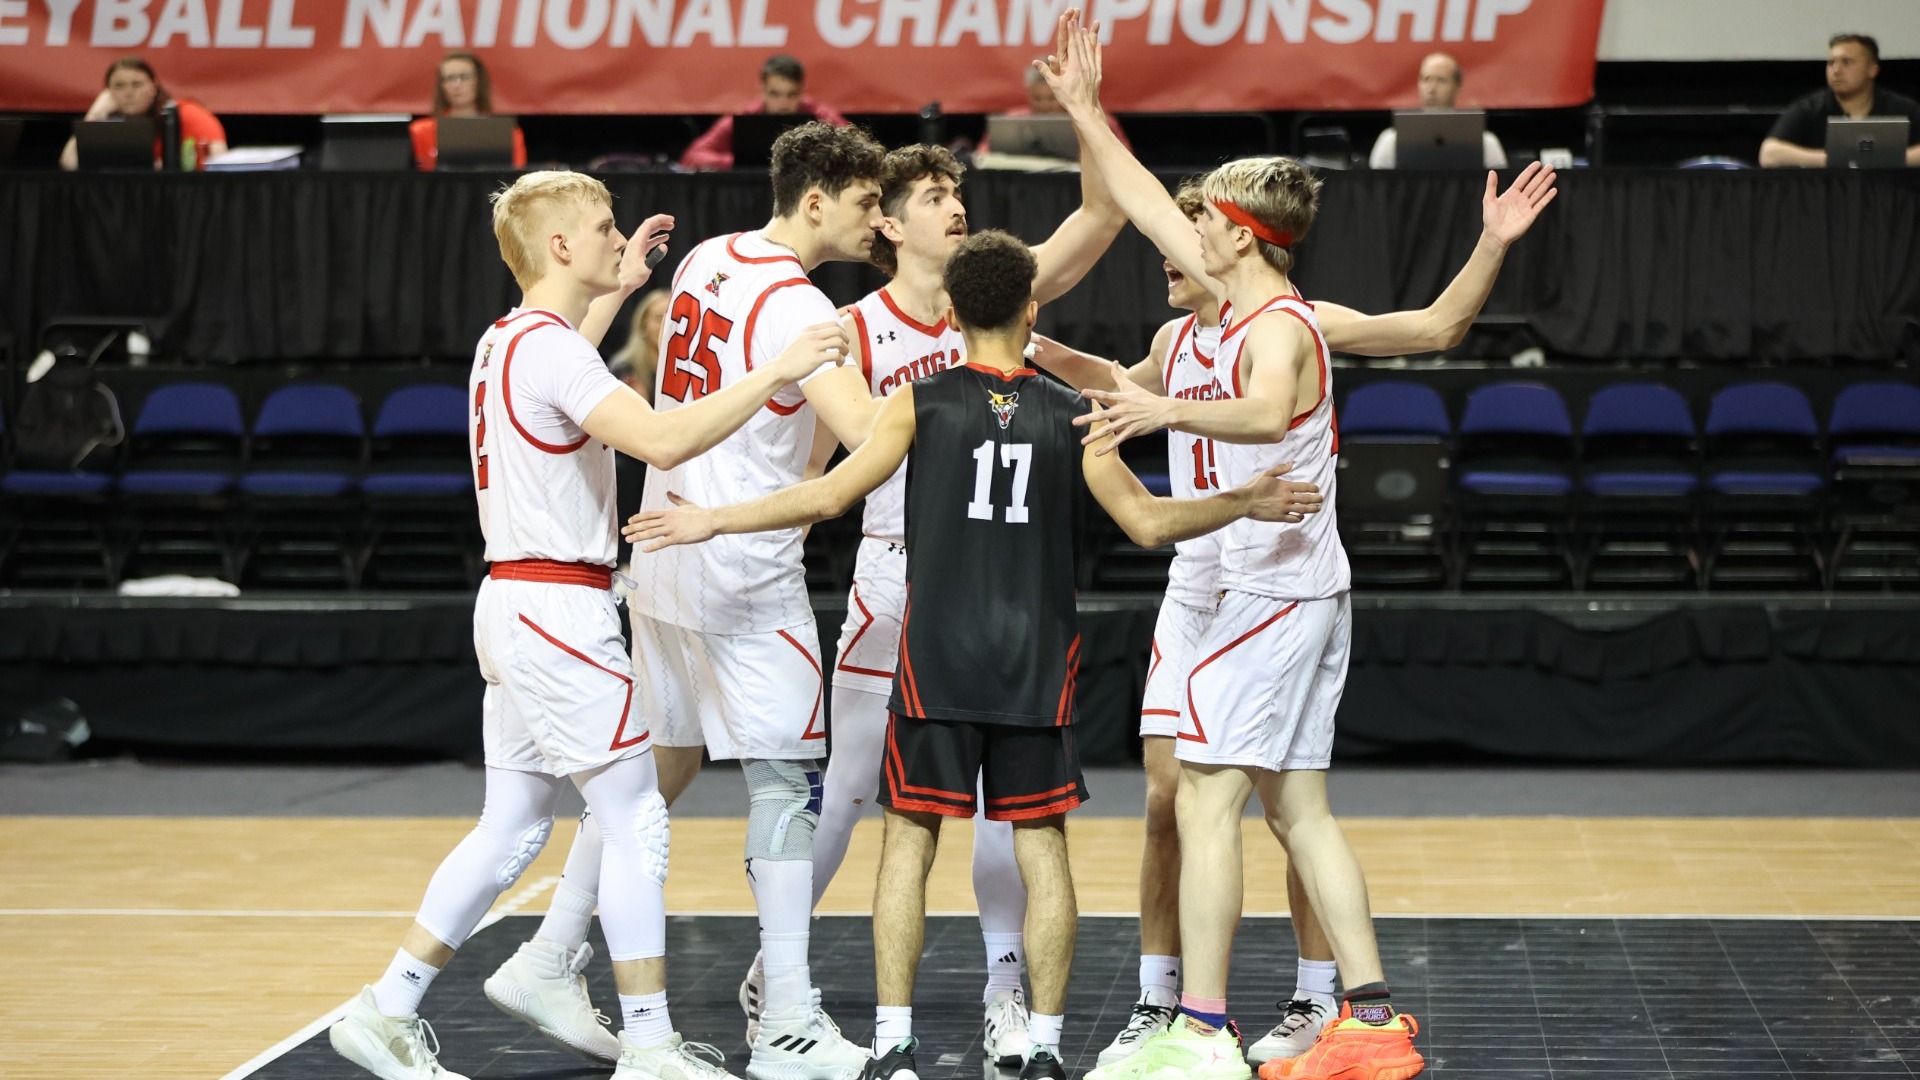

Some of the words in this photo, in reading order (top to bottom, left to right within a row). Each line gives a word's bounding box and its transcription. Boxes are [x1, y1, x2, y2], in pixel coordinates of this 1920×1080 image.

[340, 0, 788, 50] NATIONAL
[813, 0, 1534, 48] CHAMPIONSHIP
[661, 291, 734, 403] 25
[475, 381, 488, 491] 2
[968, 440, 1032, 523] 17
